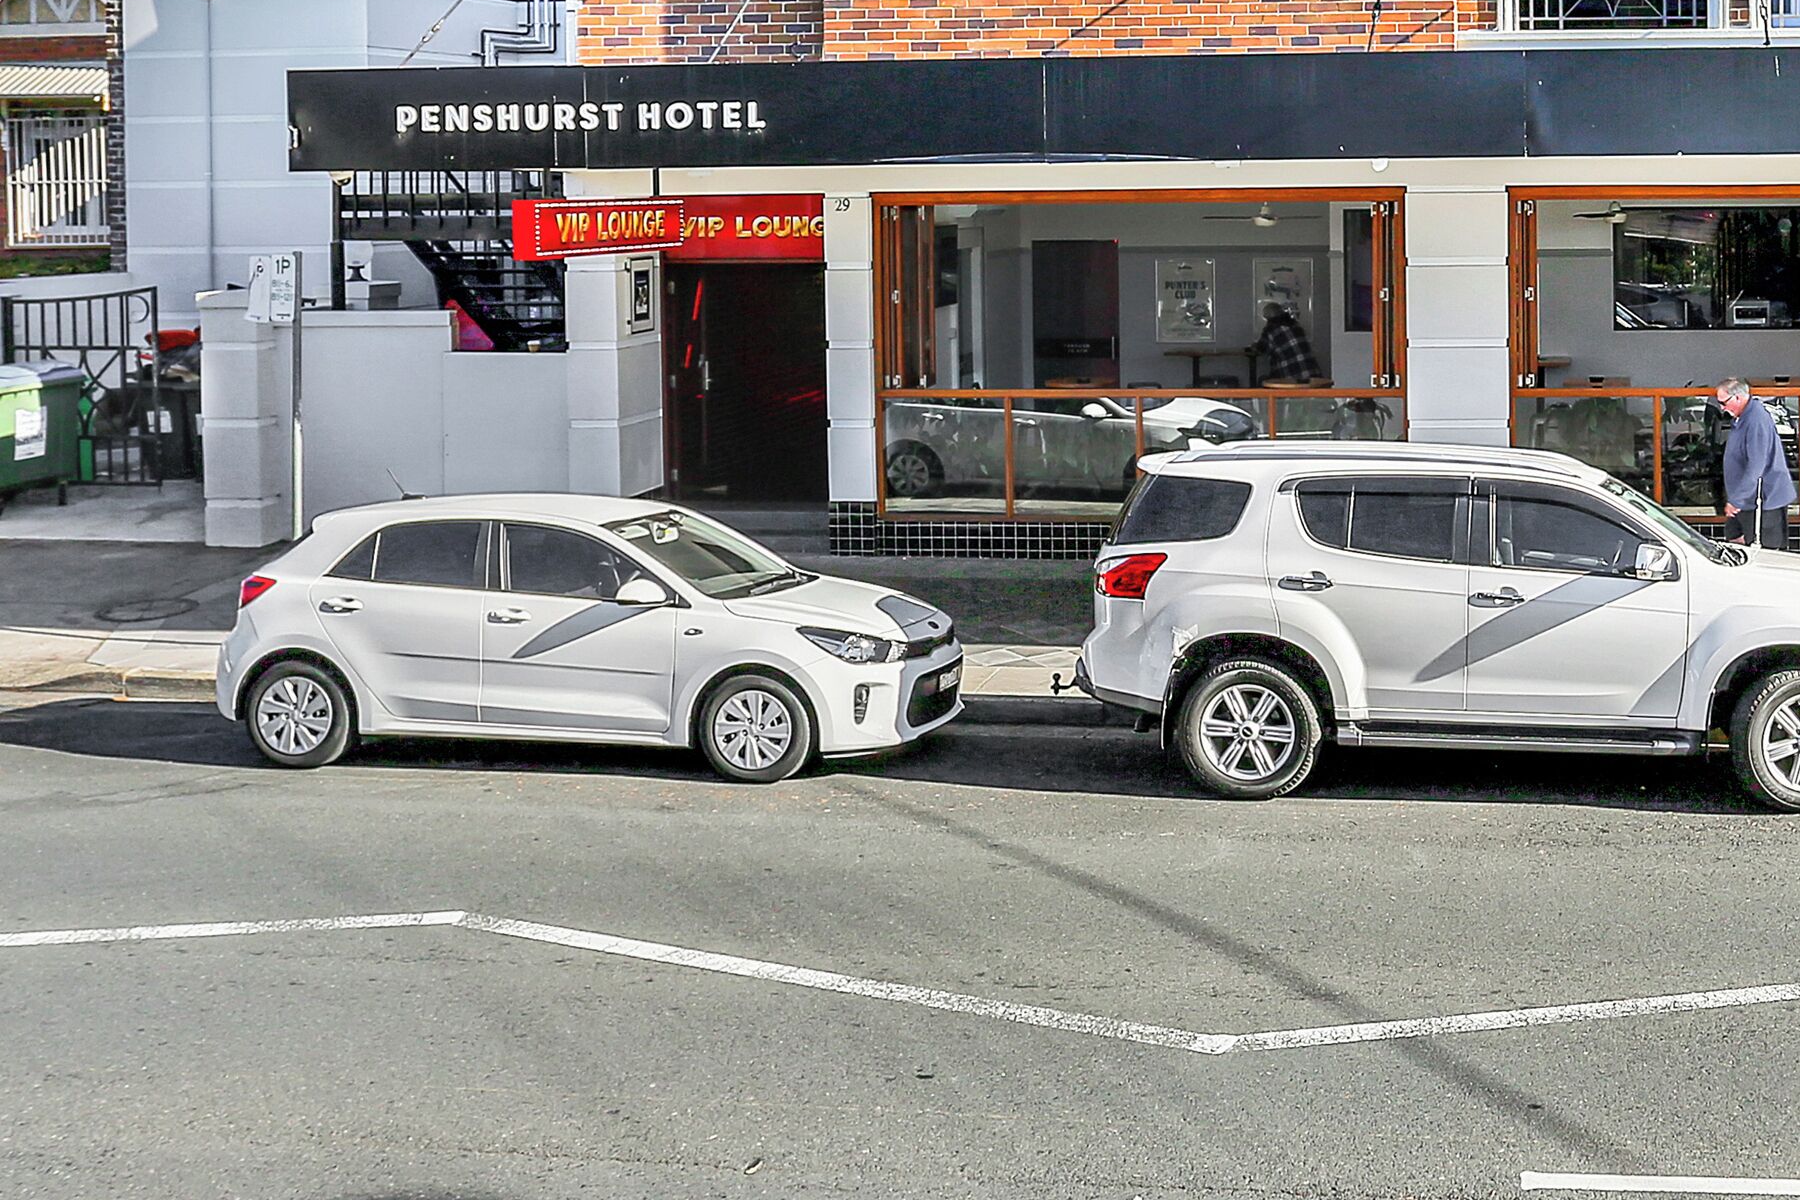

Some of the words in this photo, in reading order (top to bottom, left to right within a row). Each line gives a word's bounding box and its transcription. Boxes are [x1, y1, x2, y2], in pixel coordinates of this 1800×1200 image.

[395, 102, 624, 133] PENSHURST
[637, 101, 767, 130] HOTEL
[834, 198, 851, 212] 29
[555, 211, 590, 243] VIP
[597, 209, 665, 241] LOUNGE
[682, 216, 725, 238] VIP
[275, 258, 291, 275] 1P
